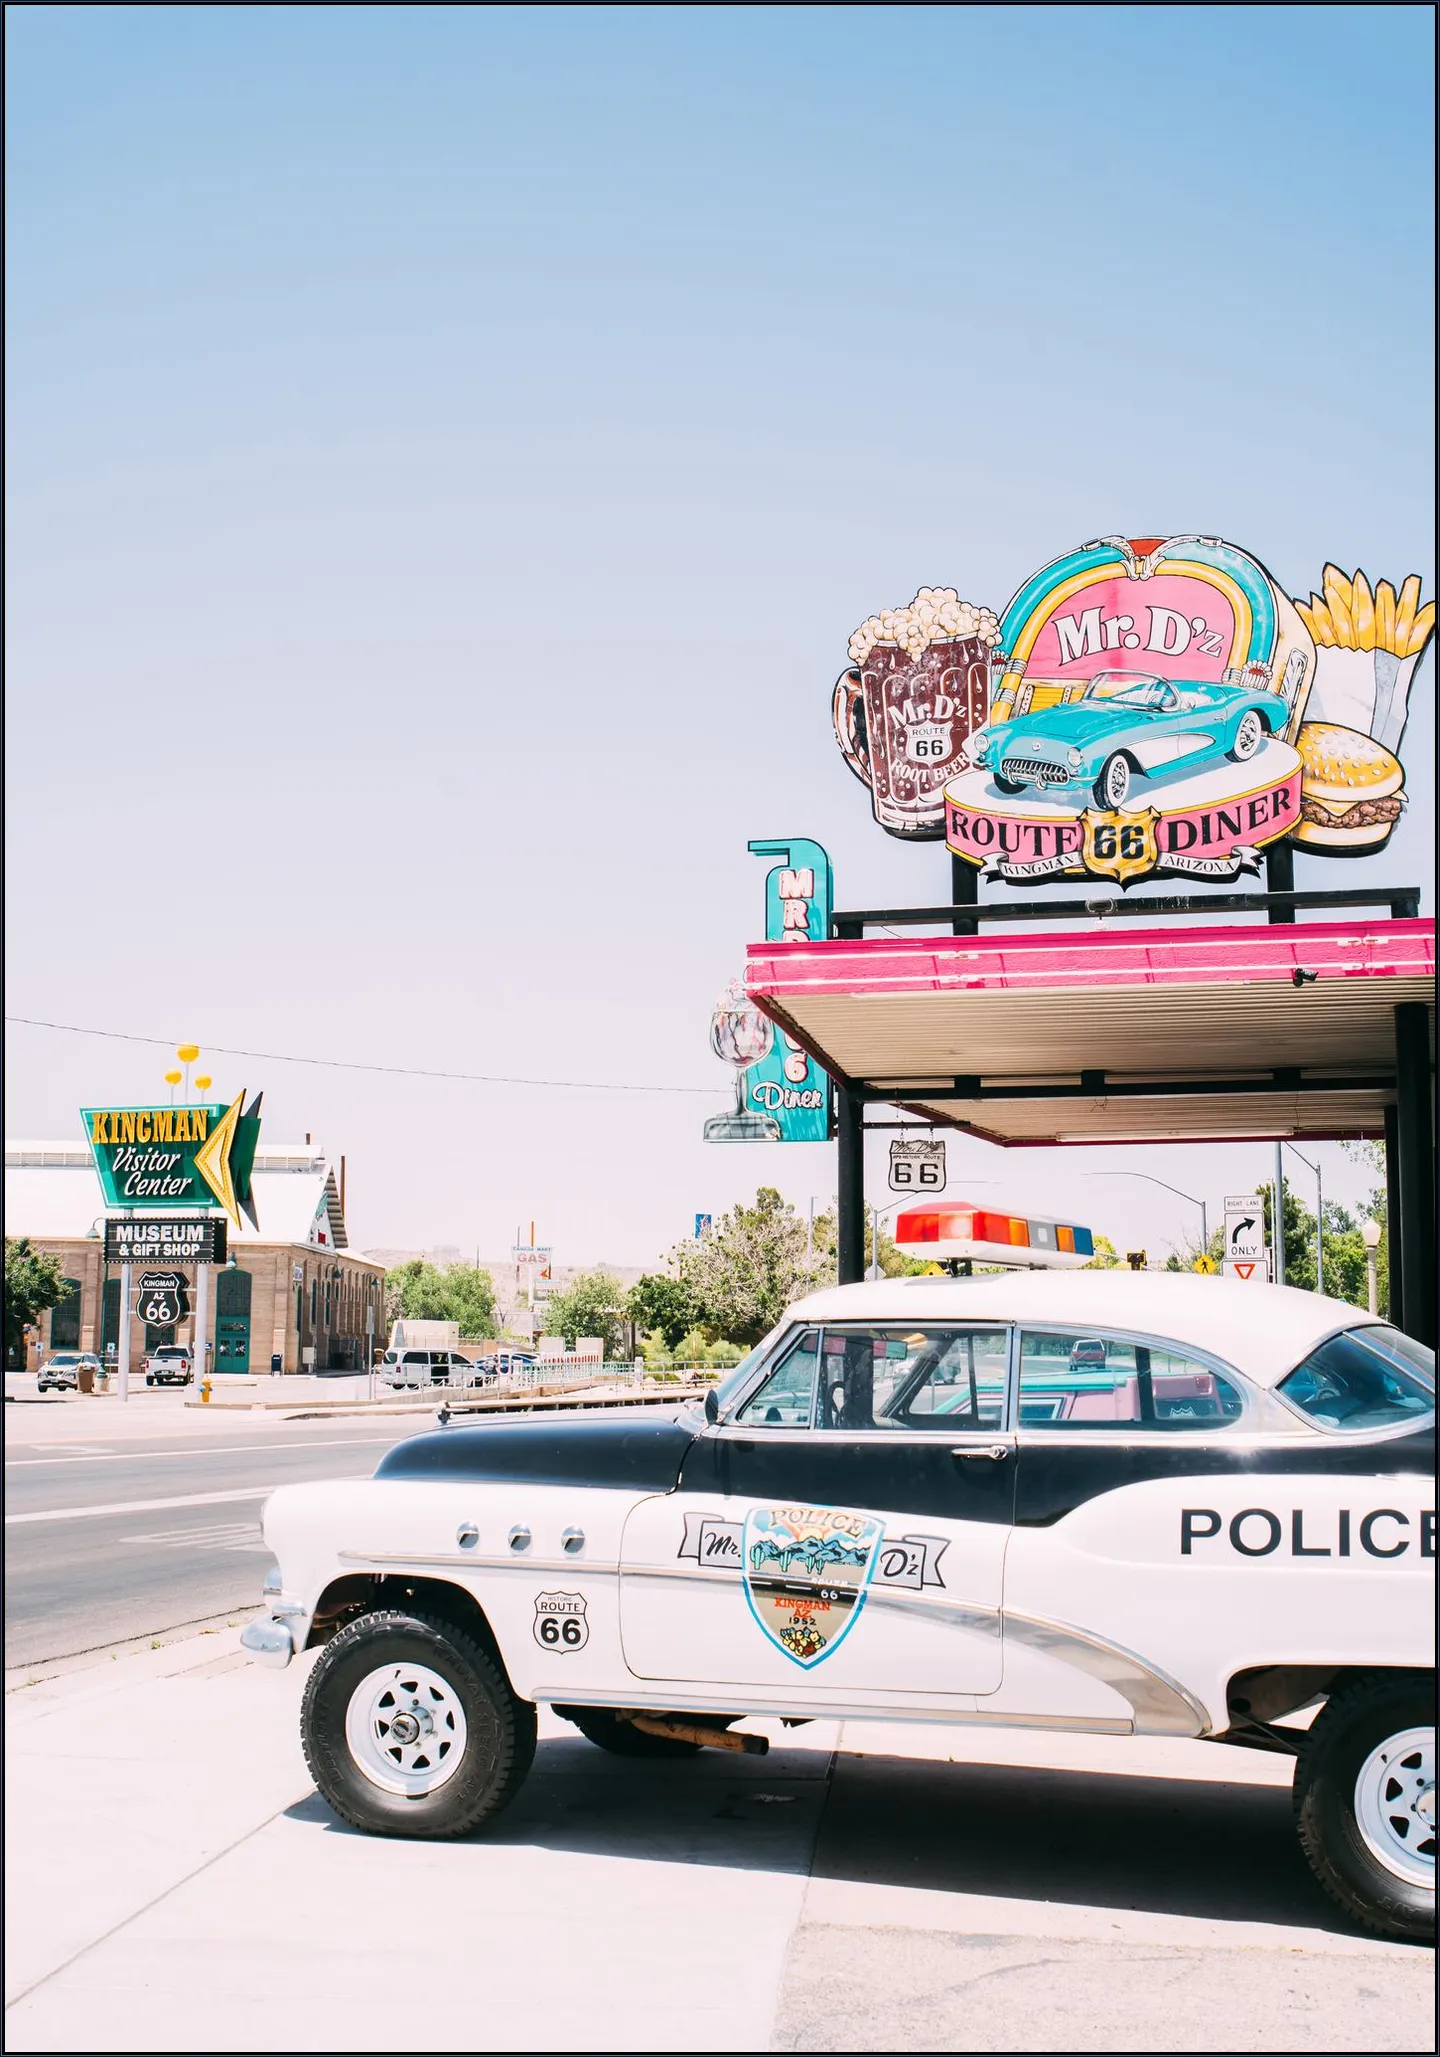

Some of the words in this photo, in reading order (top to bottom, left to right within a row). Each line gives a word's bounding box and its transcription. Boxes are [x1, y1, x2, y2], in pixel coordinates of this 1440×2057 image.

[1052, 606, 1140, 666] Mr.
[912, 727, 945, 735] ROUTE
[916, 739, 943, 756] 66
[891, 758, 929, 783] ROOT
[933, 752, 970, 781] BEER
[952, 808, 1079, 857] ROUTE
[1093, 825, 1145, 860] 66
[1167, 786, 1292, 853] DINER
[1003, 853, 1076, 874] KINGMAN
[1164, 856, 1236, 873] ARIZONA
[752, 1081, 823, 1110] Diner
[91, 1109, 208, 1144] KINGMAN
[112, 1146, 182, 1173] Visitor
[894, 1162, 939, 1184] 66
[123, 1171, 192, 1196] Center
[116, 1225, 204, 1242] MUSEUM
[118, 1244, 130, 1256] &
[132, 1243, 160, 1256] GIFT
[163, 1243, 200, 1256] SHOP
[517, 1252, 548, 1264] GAS
[1231, 1246, 1258, 1256] ONLY
[143, 1279, 175, 1288] KINGMAN
[153, 1292, 165, 1300] AZ
[145, 1301, 171, 1320] 66
[769, 1507, 869, 1540] POLICE
[704, 1532, 741, 1559] Mr.
[820, 1589, 839, 1600] 66
[540, 1602, 581, 1612] ROUTE
[774, 1597, 831, 1612] KINGMAN
[789, 1616, 818, 1626] 1952
[540, 1617, 581, 1645] 66
